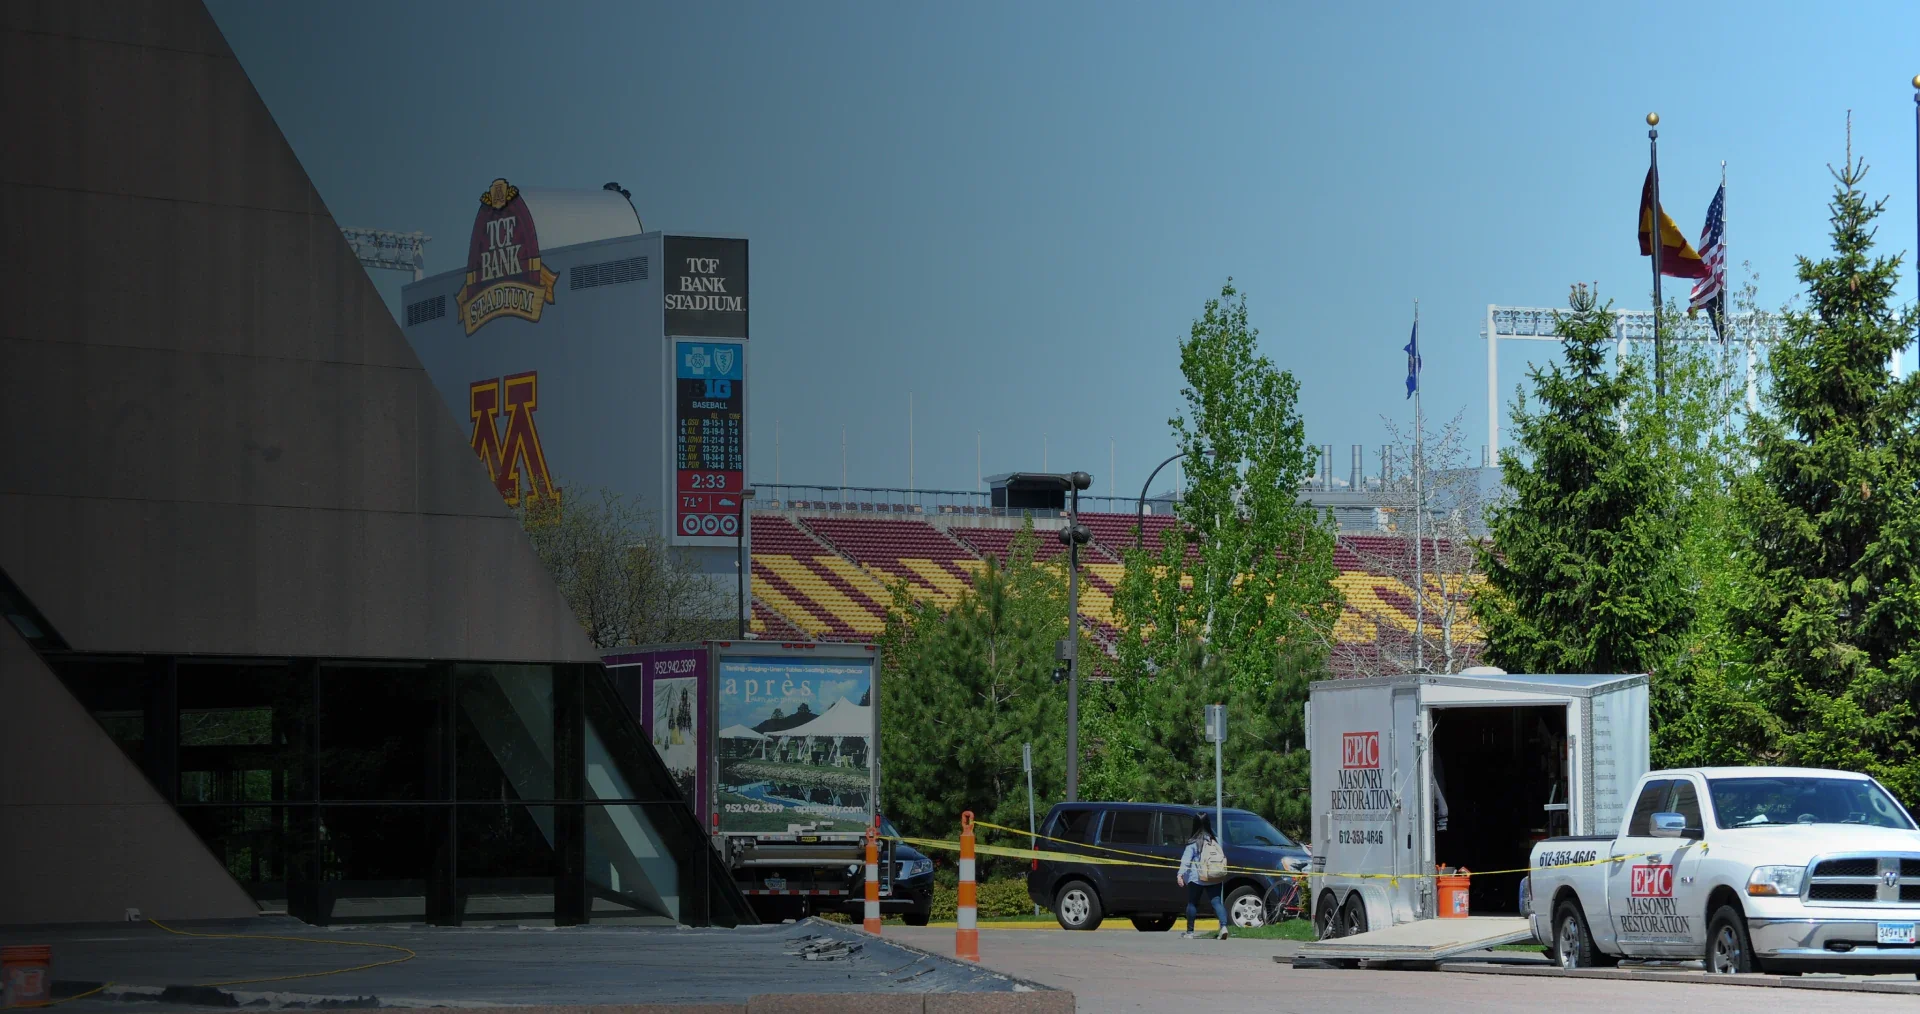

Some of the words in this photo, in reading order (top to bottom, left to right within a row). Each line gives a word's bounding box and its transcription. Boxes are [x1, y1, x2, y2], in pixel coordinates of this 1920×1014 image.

[487, 216, 516, 250] TCF
[481, 244, 522, 282] BANK
[686, 258, 720, 274] TCF
[680, 276, 726, 292] BANK
[470, 286, 534, 323] STADIUM
[665, 294, 742, 311] STADIUM
[692, 474, 725, 488] 2:33
[683, 497, 702, 507] 71°
[655, 659, 696, 674] 952.942.3399
[726, 673, 812, 703] après
[1344, 735, 1378, 766] EPIC
[1338, 769, 1384, 789] MASONRY
[1331, 790, 1394, 809] RESTORATION
[725, 804, 784, 813] 952.942.3399
[1339, 830, 1383, 844] 612-353-4646
[1540, 850, 1596, 866] 612-353-4646
[1632, 867, 1672, 895] EPIC
[1626, 898, 1678, 915] MASONRY
[1620, 916, 1690, 933] RESTORATION
